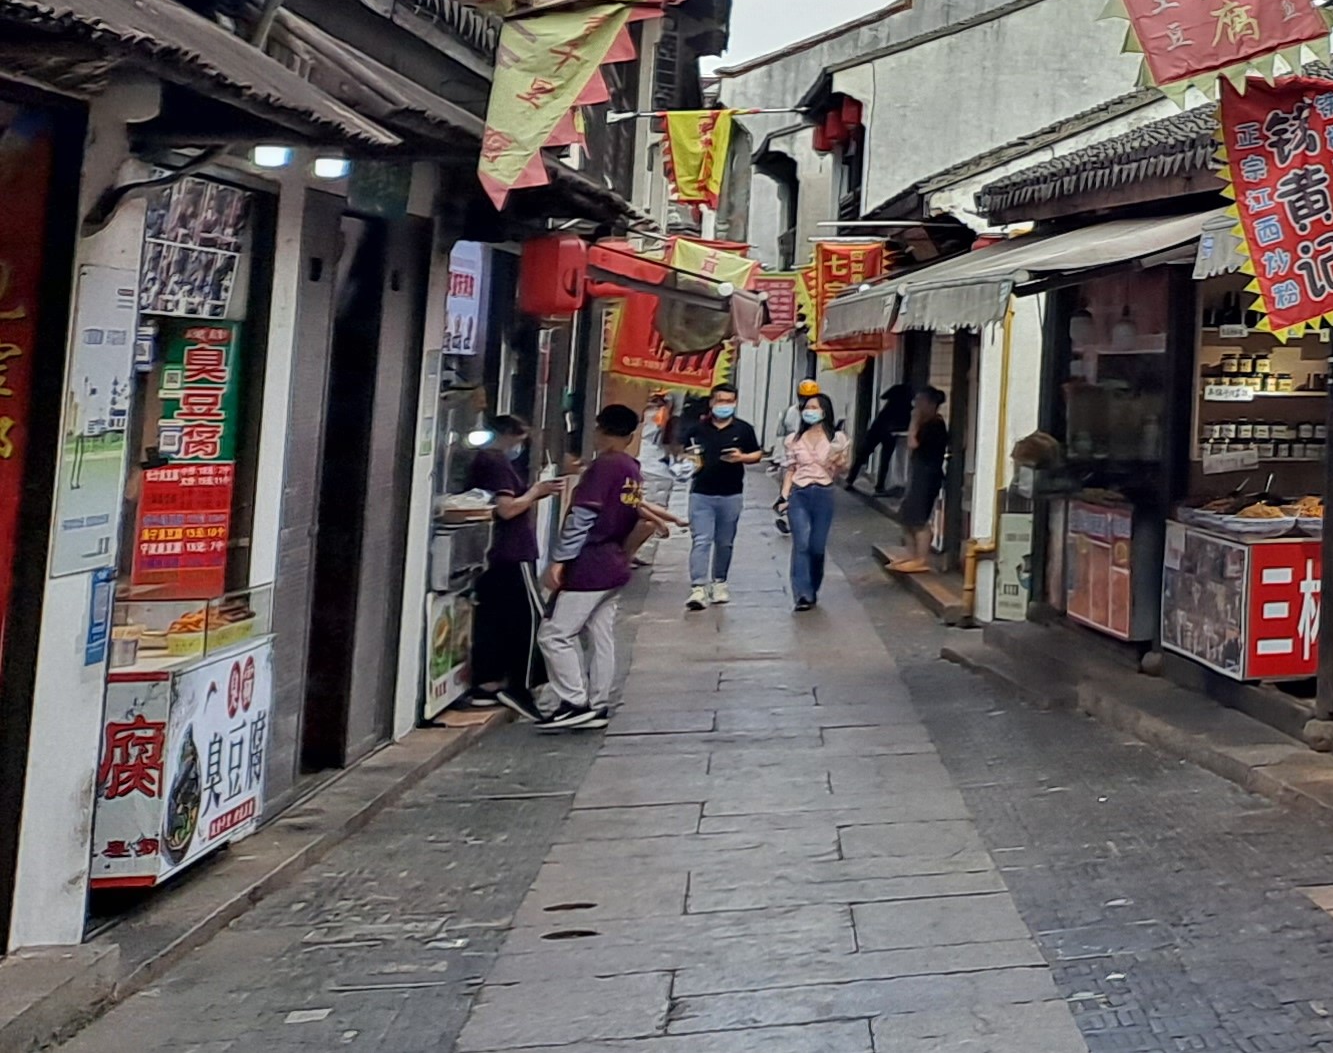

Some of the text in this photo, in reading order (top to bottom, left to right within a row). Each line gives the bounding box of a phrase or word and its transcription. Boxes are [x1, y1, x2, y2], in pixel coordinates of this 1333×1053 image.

[1234, 121, 1301, 310] 正宗江西炒粉
[173, 343, 230, 459] 臭豆腐
[100, 713, 167, 800] 腐
[202, 709, 267, 818] 臭豆腐
